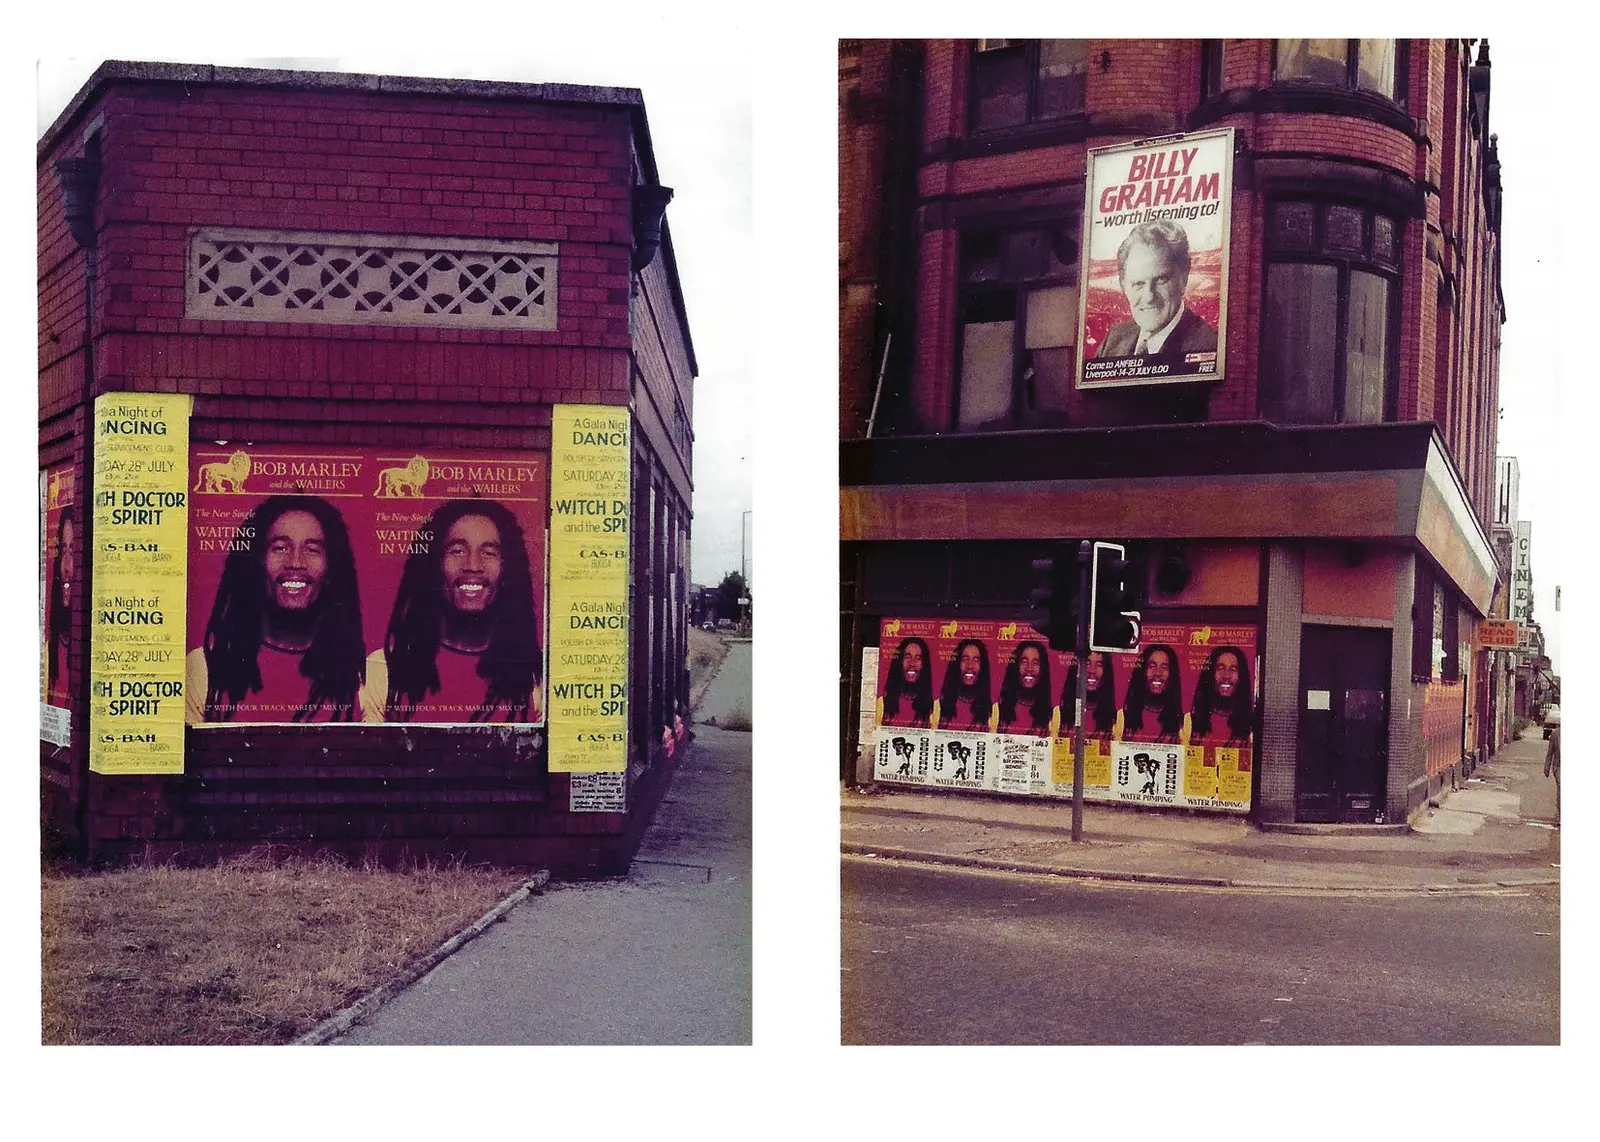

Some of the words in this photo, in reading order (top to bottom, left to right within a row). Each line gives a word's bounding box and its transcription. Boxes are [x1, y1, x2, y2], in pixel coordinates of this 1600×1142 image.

[1127, 147, 1199, 183] BILLY
[1099, 172, 1220, 214] GRAHAM
[1143, 204, 1199, 222] listening
[1200, 200, 1220, 217] to!
[1086, 361, 1106, 371] Come
[1106, 361, 1114, 369] to
[1114, 358, 1144, 369] ANFIELD
[1135, 366, 1152, 376] JULY
[118, 405, 149, 420] Night
[151, 405, 163, 418] of
[573, 418, 581, 429] A
[582, 417, 606, 430] Gala
[148, 460, 175, 473] JULY
[253, 461, 287, 476] BOB
[291, 462, 363, 478] MARLEY
[431, 466, 465, 481] BOB
[468, 467, 537, 482] MARLEY
[563, 470, 615, 483] SATURDAY
[269, 480, 283, 489] and
[283, 480, 294, 489] the
[295, 479, 346, 490] WAILERS
[446, 483, 460, 493] and
[461, 483, 472, 493] the
[473, 483, 521, 494] WAILERS
[123, 491, 185, 508] DOCTOR
[195, 508, 212, 518] The
[212, 509, 231, 518] New
[232, 509, 256, 520] Single
[555, 500, 606, 516] WITCH
[112, 508, 163, 526] SPIRIT
[375, 512, 392, 522] The
[392, 512, 410, 522] New
[411, 512, 434, 524] Single
[195, 526, 256, 538] WAITING
[563, 521, 584, 534] and
[585, 521, 600, 534] the
[375, 530, 434, 541] WAITING
[199, 540, 215, 551] IN
[219, 540, 251, 551] VAIN
[380, 543, 395, 554] IN
[398, 543, 429, 554] VAIN
[1513, 537, 1529, 628] CINEM
[115, 596, 145, 611] Night
[147, 596, 160, 608] of
[570, 602, 579, 613] A
[581, 601, 603, 614] Gala
[1157, 629, 1185, 637] MARLEY
[1225, 630, 1255, 638] MARLEY
[1480, 635, 1514, 645] CLUB
[144, 650, 172, 663] JULY
[561, 653, 613, 666] SATURDAY
[120, 681, 183, 698] DOCTOR
[553, 683, 604, 699] WITCH
[109, 699, 160, 716] SPIRIT
[286, 704, 318, 712] MARLEY
[465, 704, 495, 712] MARLEY
[561, 704, 582, 717] and
[583, 704, 598, 717] the
